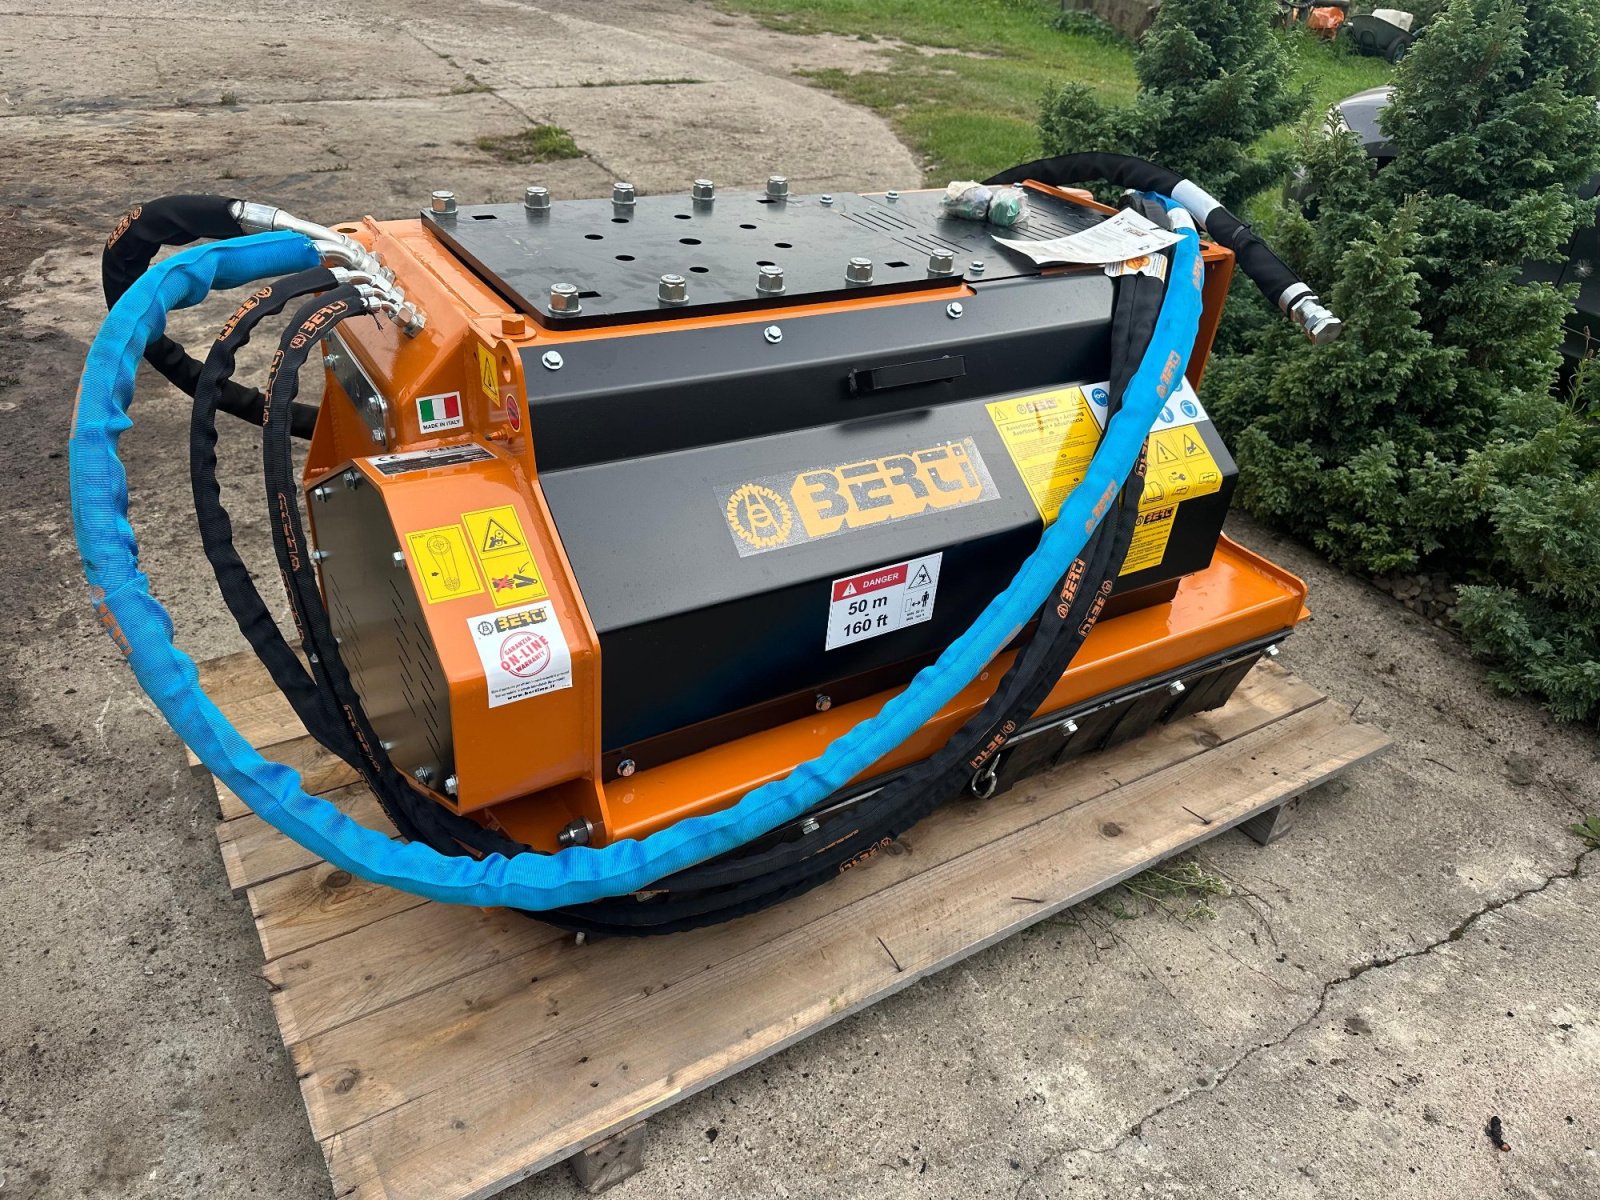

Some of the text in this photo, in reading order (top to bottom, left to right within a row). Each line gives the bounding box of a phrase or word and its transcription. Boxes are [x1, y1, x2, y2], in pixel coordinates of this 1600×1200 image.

[862, 572, 899, 588] DANGER
[848, 596, 888, 615] 50 m
[843, 619, 871, 637] 160
[876, 614, 888, 627] ft
[501, 636, 549, 671] ON-LINE
[515, 651, 545, 672] WARRANTY
